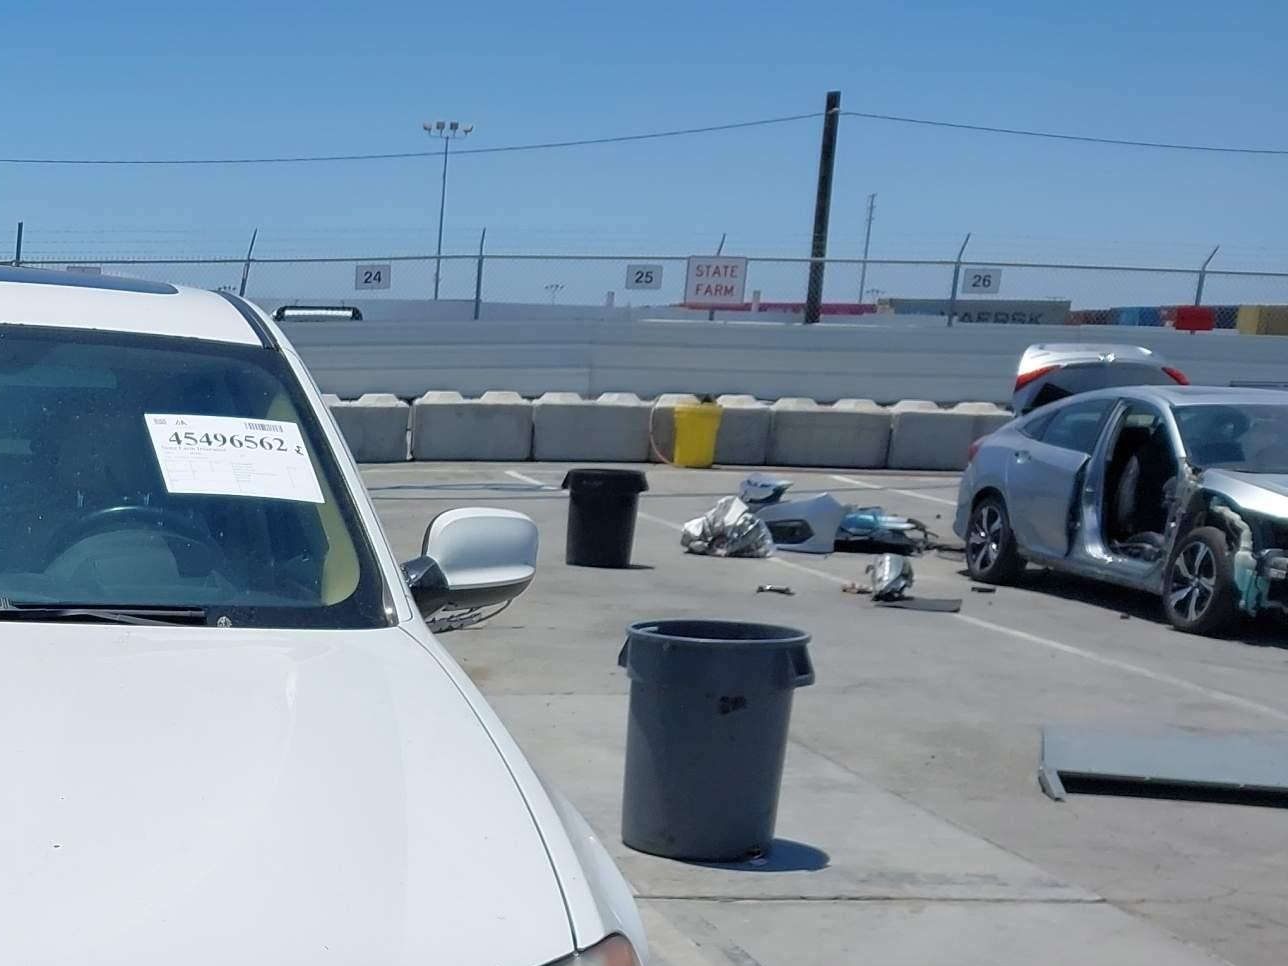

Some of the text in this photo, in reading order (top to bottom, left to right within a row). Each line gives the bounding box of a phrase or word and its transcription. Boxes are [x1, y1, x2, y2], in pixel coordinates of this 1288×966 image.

[363, 271, 382, 284] 24
[634, 270, 654, 284] 25
[695, 265, 739, 278] STATE
[972, 274, 992, 288] 26
[695, 283, 735, 296] FARM
[168, 431, 288, 453] 45496562
